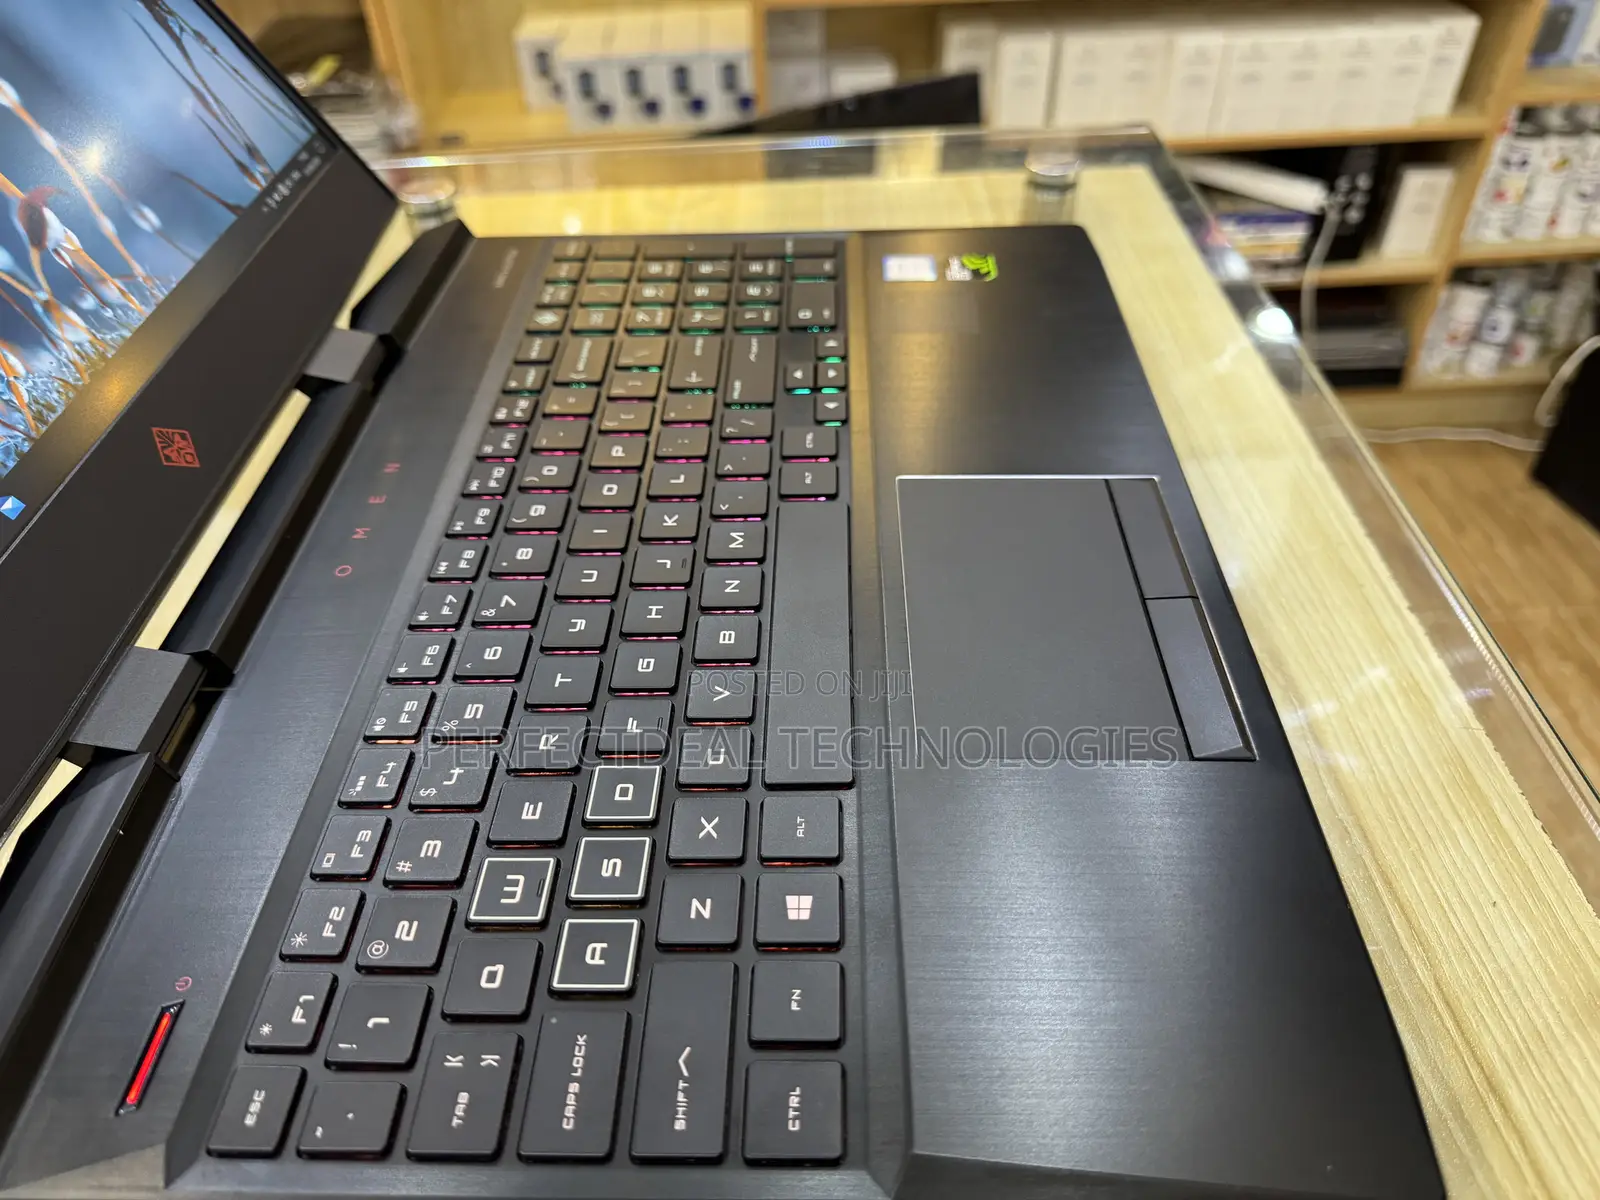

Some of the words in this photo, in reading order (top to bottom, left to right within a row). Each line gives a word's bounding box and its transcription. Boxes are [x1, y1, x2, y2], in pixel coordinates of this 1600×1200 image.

[610, 445, 626, 457] P
[487, 466, 506, 488] F10
[669, 474, 685, 484] L
[474, 507, 491, 525] F9
[529, 504, 547, 517] 9
[662, 514, 679, 526] K
[728, 532, 745, 548] M
[458, 549, 476, 569] F8
[515, 547, 534, 560] 8
[656, 559, 672, 569] J
[580, 570, 598, 583] U
[440, 594, 458, 615] F7
[499, 594, 517, 608] 7
[646, 605, 664, 619] H
[718, 630, 736, 644] B
[421, 644, 440, 666] F6
[483, 646, 503, 660] 6
[637, 658, 656, 673] G
[554, 672, 573, 688] T
[712, 685, 731, 702] V
[398, 700, 419, 724] F5
[463, 703, 484, 719] 5
[440, 719, 459, 732] %
[627, 717, 643, 733] F
[539, 734, 558, 750] R
[707, 748, 725, 765] C
[375, 761, 397, 788] F4
[442, 767, 465, 785] 4
[419, 787, 438, 797] $
[613, 783, 634, 801] D
[521, 801, 543, 820] E
[698, 816, 719, 840] X
[796, 815, 805, 838] ALT
[350, 829, 372, 858] F3
[419, 839, 442, 858] 3
[395, 860, 413, 873] #
[600, 858, 622, 878] S
[321, 906, 346, 938] F2
[394, 920, 419, 942] 2
[366, 939, 390, 960] @
[584, 942, 608, 965] A
[479, 963, 505, 989] Q
[291, 994, 315, 1024] F1
[790, 989, 802, 1011] FN
[366, 1017, 390, 1029] 1
[570, 1034, 587, 1077] LOCK
[243, 1089, 266, 1126] ESC
[451, 1091, 470, 1127] TAB
[561, 1082, 580, 1130] CAPS
[673, 1079, 689, 1131] SHIFT
[787, 1086, 801, 1131] CTRL
